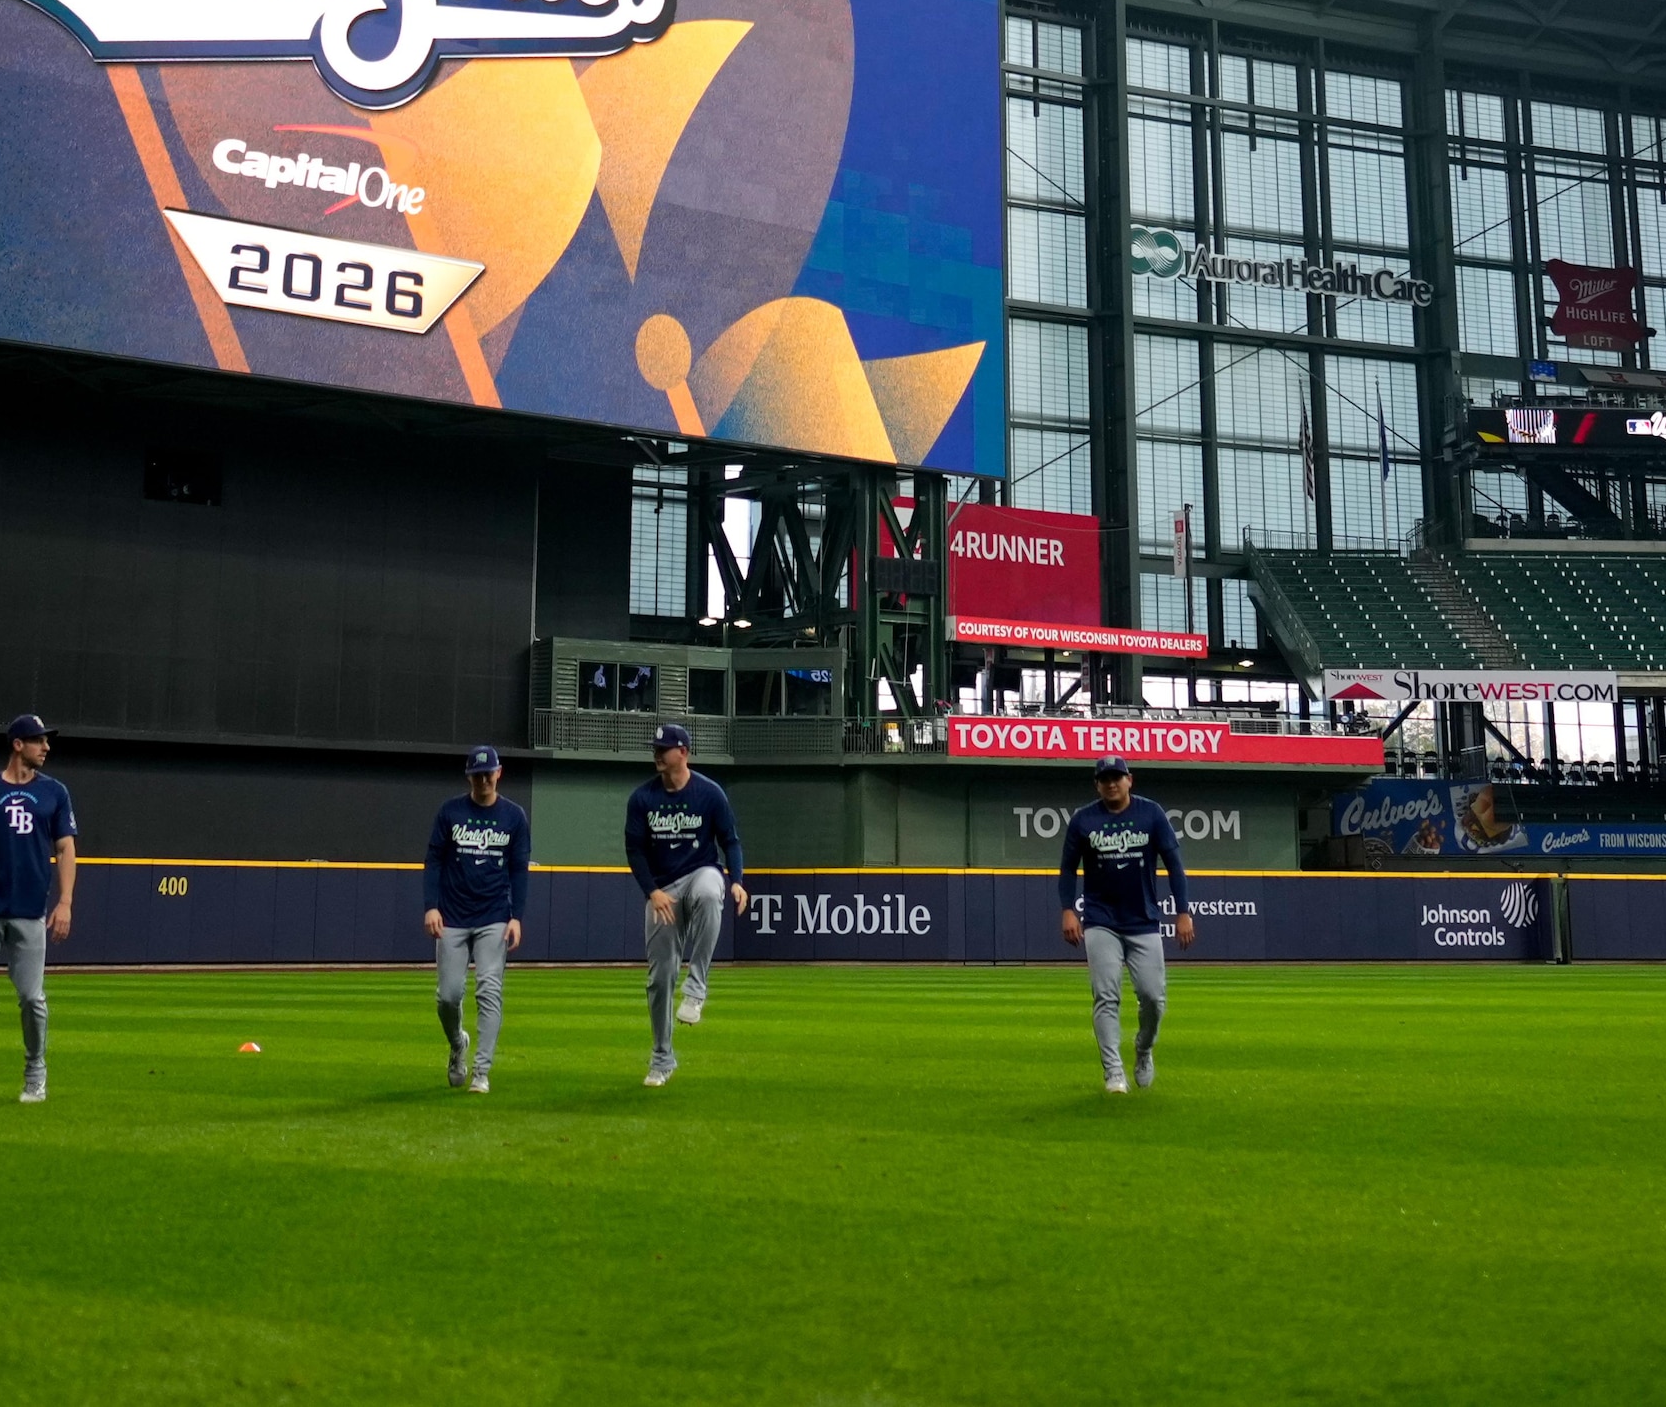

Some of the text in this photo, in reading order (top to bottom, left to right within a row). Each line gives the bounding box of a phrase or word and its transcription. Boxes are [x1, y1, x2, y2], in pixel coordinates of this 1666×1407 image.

[227, 242, 425, 320] 2026
[1189, 243, 1432, 306] Aurora Health Care
[1569, 278, 1617, 304] Miller
[1565, 305, 1626, 325] HIGH LIFE
[1583, 335, 1613, 349] LOFT
[950, 530, 1065, 567] 4RUNNER
[958, 622, 1203, 652] COURTESY OF YOUR WISCONSIN TOYOTA DEALERS
[955, 723, 1223, 754] TOYOTA TERRITORY
[4, 805, 34, 835] TB
[1340, 789, 1445, 836] Culver's
[1541, 828, 1590, 853] Culver's
[1599, 833, 1625, 849] FROM
[158, 876, 188, 896] 400
[794, 893, 931, 936] Mobile
[1421, 903, 1490, 926] Johnson
[1434, 926, 1505, 947] Controls
